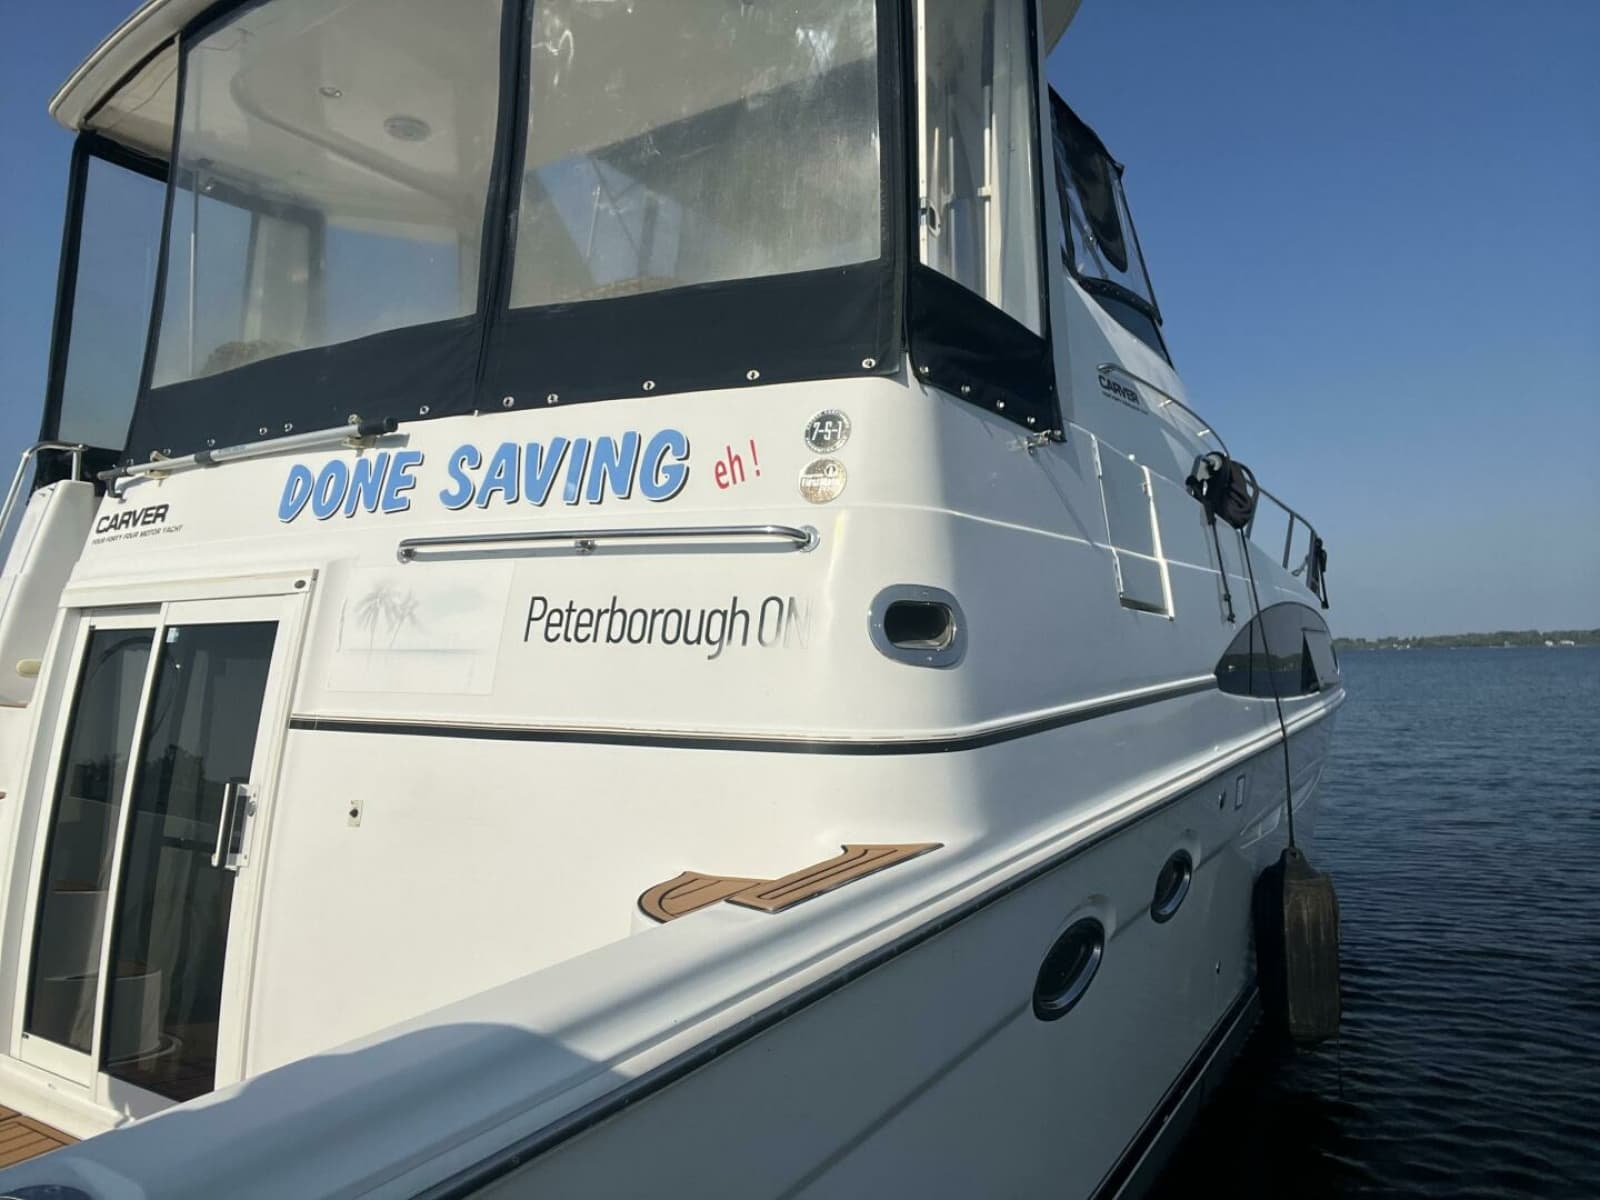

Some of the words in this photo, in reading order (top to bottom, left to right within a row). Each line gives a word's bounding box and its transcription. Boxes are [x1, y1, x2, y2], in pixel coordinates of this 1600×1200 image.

[278, 449, 424, 523] DONE
[439, 428, 690, 511] SAVING
[95, 503, 170, 535] CARVER
[139, 527, 162, 538] MOTOR
[162, 524, 184, 535] YACHT
[523, 595, 751, 661] Peterborough
[757, 595, 808, 649] ON
